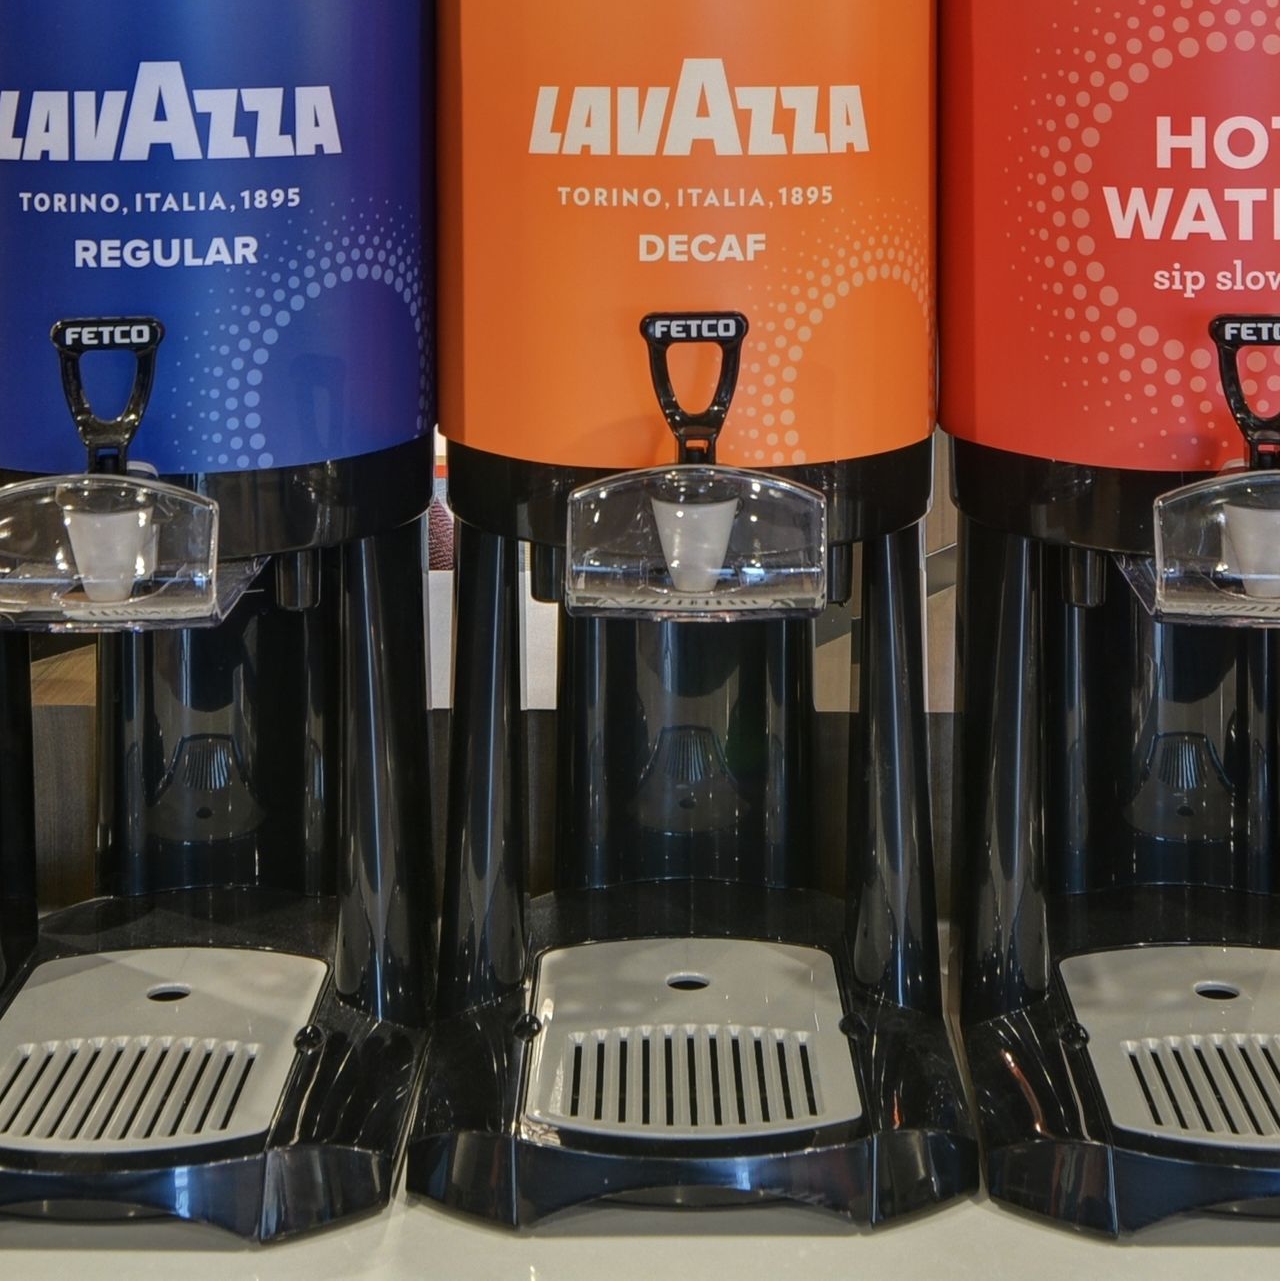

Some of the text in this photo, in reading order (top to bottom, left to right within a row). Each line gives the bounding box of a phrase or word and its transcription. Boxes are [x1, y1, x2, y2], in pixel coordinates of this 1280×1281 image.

[528, 57, 870, 156] LAVAZZA
[19, 187, 301, 214] TORINO, ITALIA, 1895
[558, 185, 833, 209] TORINO, ITALIA, 1895
[75, 236, 258, 268] REGULAR
[639, 234, 766, 263] DECAF
[1153, 260, 1206, 299] sip
[65, 325, 150, 345] FETCO
[655, 319, 737, 338] FETCO
